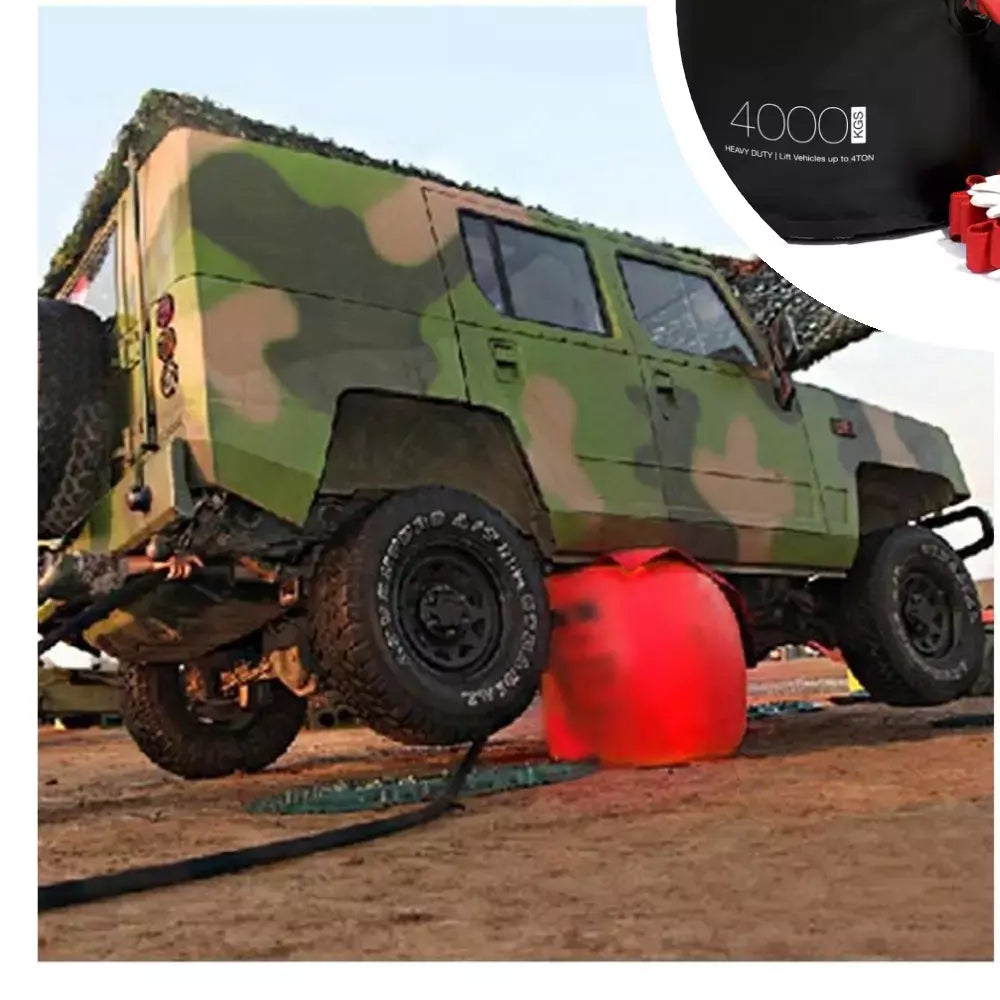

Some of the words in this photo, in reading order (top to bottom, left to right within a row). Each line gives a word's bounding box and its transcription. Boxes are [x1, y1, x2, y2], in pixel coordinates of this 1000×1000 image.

[730, 101, 849, 145] 4000
[853, 111, 864, 139] KGS
[725, 144, 750, 155] HEAVY
[751, 149, 773, 159] DUTY
[779, 153, 792, 161] Lift
[793, 153, 826, 163] Vehicles
[828, 155, 839, 164] up
[840, 154, 849, 162] to
[850, 153, 875, 163] 4TON
